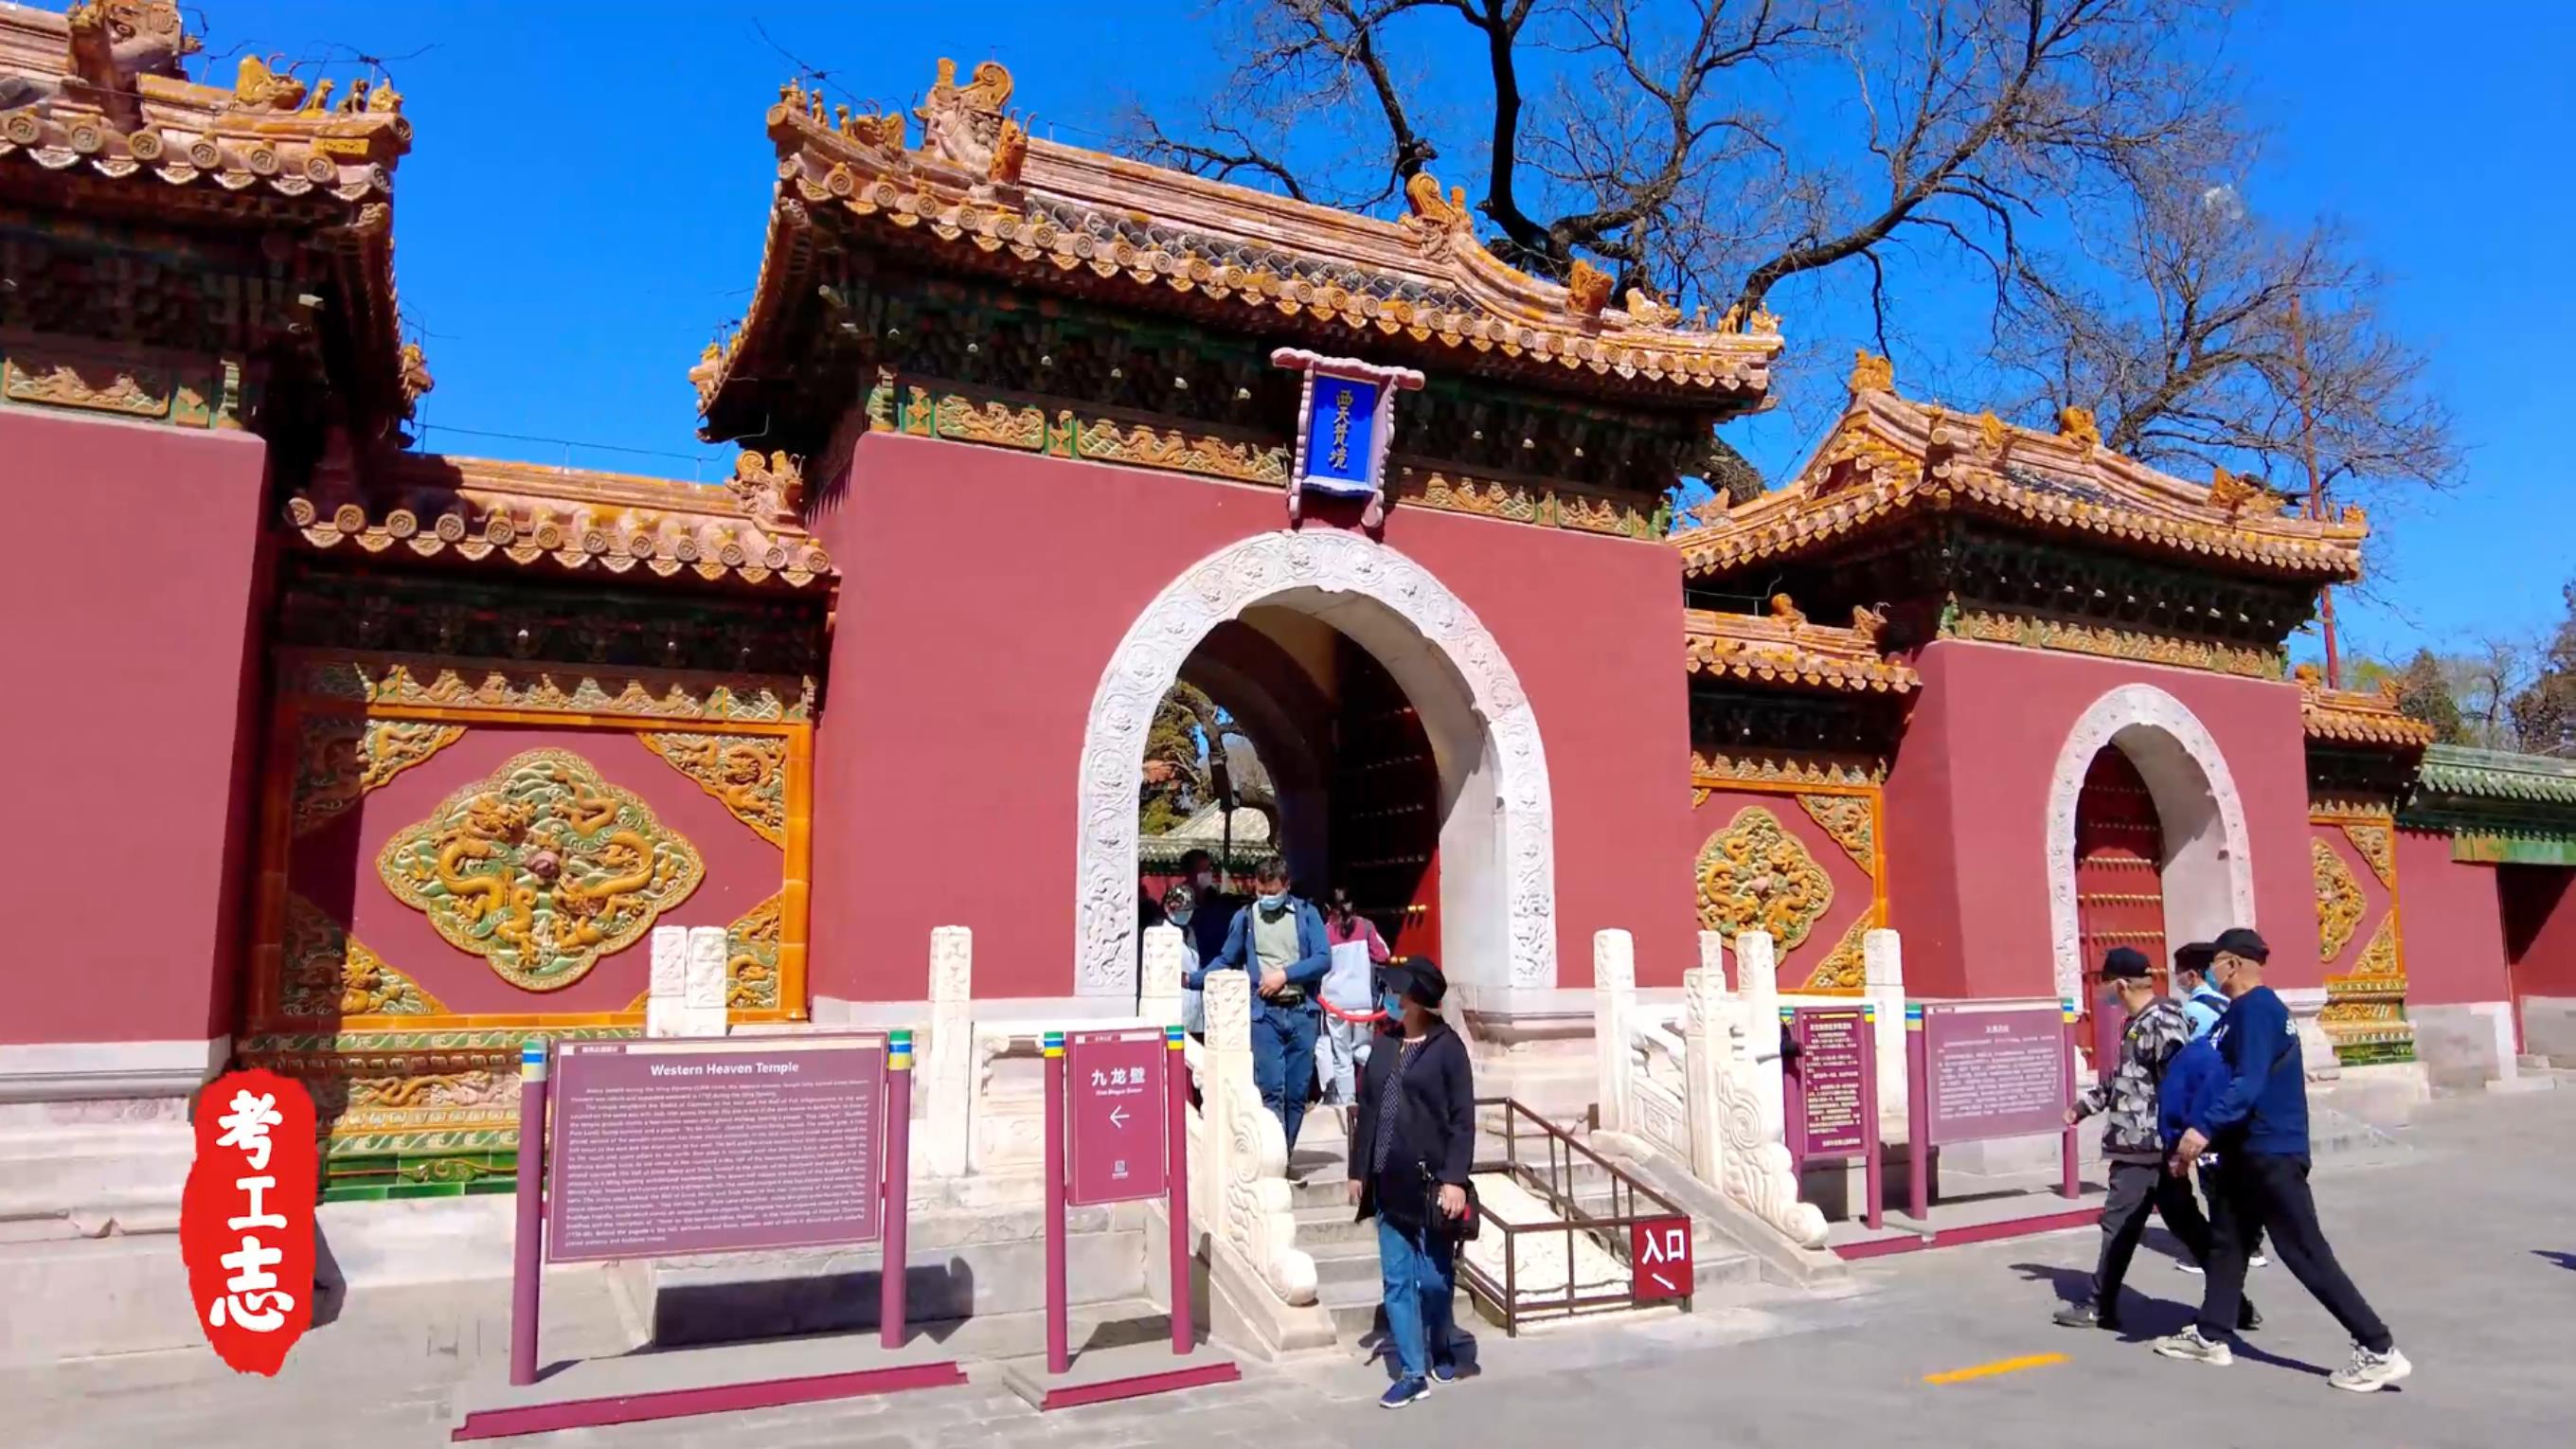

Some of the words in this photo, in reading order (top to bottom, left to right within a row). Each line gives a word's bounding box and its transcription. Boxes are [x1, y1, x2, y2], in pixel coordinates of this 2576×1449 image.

[651, 1064, 703, 1077] Western
[707, 1063, 753, 1075] Heaven
[756, 1062, 799, 1075] Temple
[1091, 1066, 1146, 1086] 九龙壁
[1641, 1228, 1686, 1265] 入口
